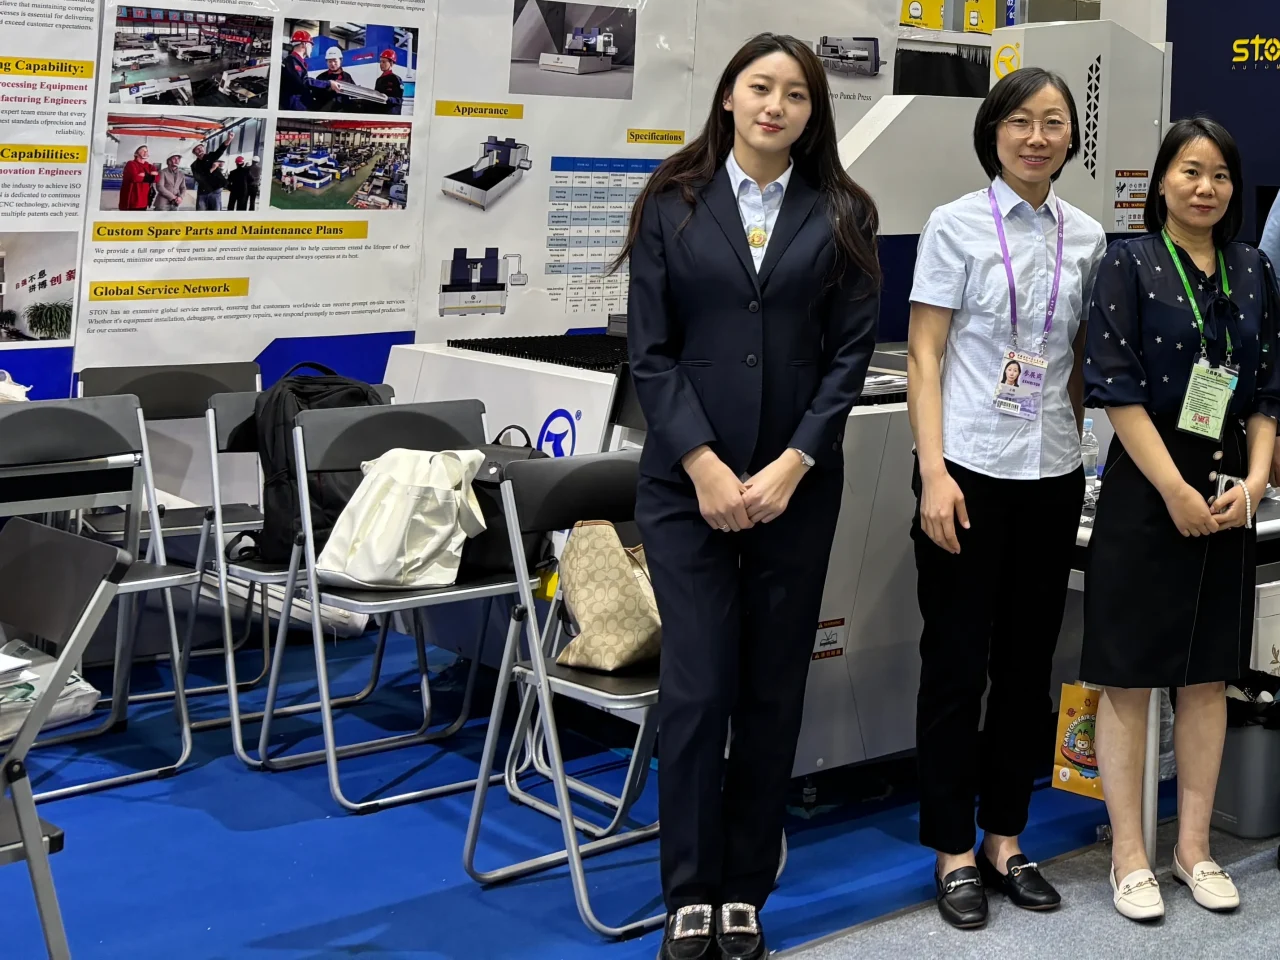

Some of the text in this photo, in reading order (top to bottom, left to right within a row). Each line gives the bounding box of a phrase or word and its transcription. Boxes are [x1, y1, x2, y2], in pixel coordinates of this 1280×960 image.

[30, 3, 67, 12] maintaining
[67, 5, 95, 13] complete
[53, 12, 63, 20] for
[64, 13, 94, 23] delivering
[15, 60, 83, 75] Capability:
[40, 82, 87, 91] Equipment
[0, 95, 86, 105] facturing Engineers
[69, 111, 87, 119] every
[453, 104, 509, 117] Appearance
[54, 128, 86, 137] reliability.
[629, 131, 682, 143] Specifications
[0, 149, 79, 161] Capabilities:
[38, 168, 81, 176] Engineers
[11, 182, 37, 190] industry
[15, 201, 49, 209] technology,
[50, 201, 80, 209] achieving
[0, 210, 26, 219] multiple
[96, 226, 343, 238] Custom Spare Parts and Maintenance Plans
[93, 283, 229, 296] Global Service Network
[1063, 720, 1078, 747] CANTON
